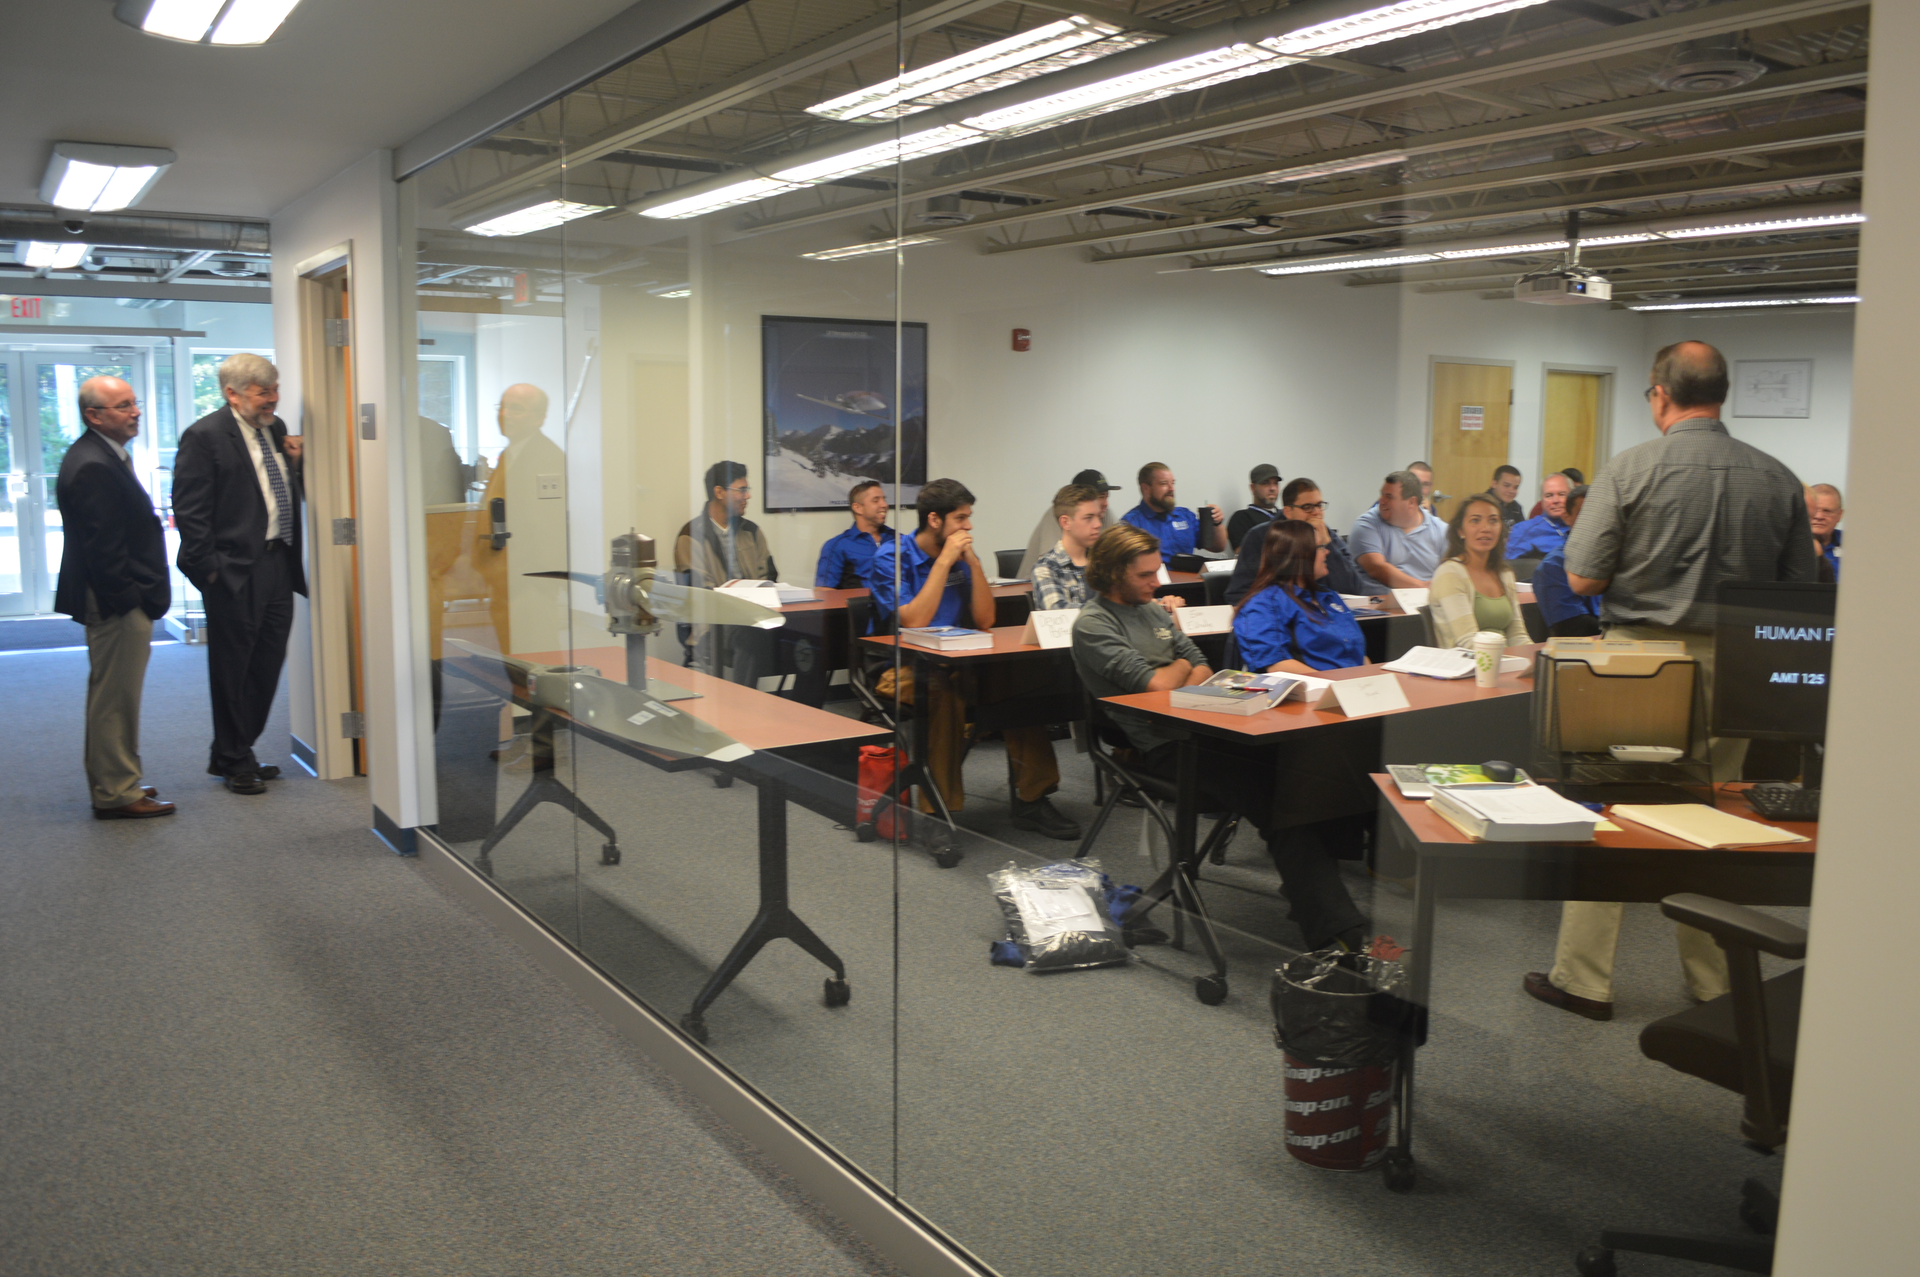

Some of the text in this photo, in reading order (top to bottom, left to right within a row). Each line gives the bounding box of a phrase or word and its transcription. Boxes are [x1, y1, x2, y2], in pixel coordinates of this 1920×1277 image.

[11, 297, 41, 317] EXIT
[1754, 625, 1822, 641] HUMAN
[1769, 672, 1825, 685] AMT 125
